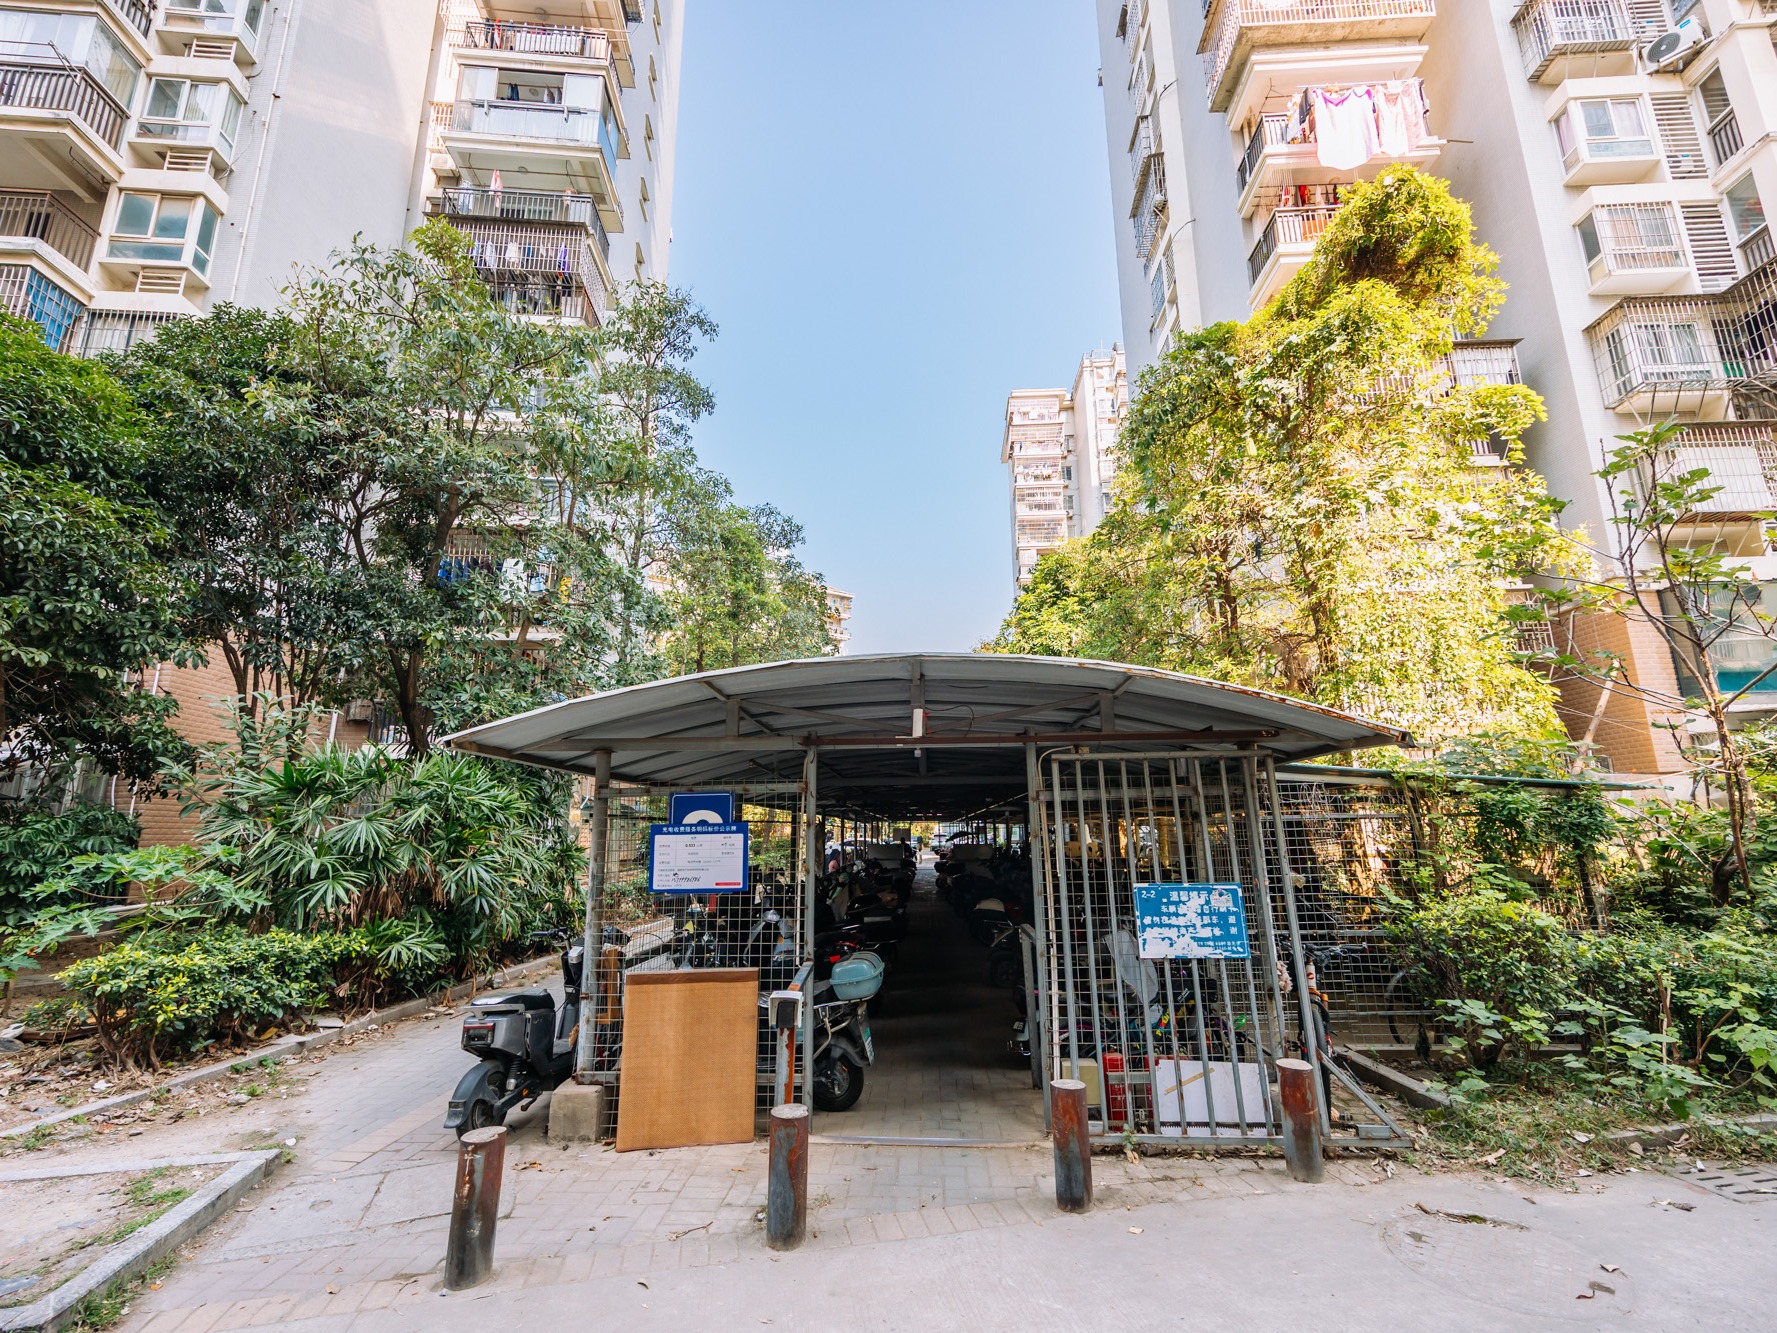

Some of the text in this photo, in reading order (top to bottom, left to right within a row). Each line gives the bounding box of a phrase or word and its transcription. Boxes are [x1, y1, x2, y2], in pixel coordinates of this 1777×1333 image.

[1141, 890, 1156, 899] 2-2
[1169, 890, 1209, 902] 温馨提示
